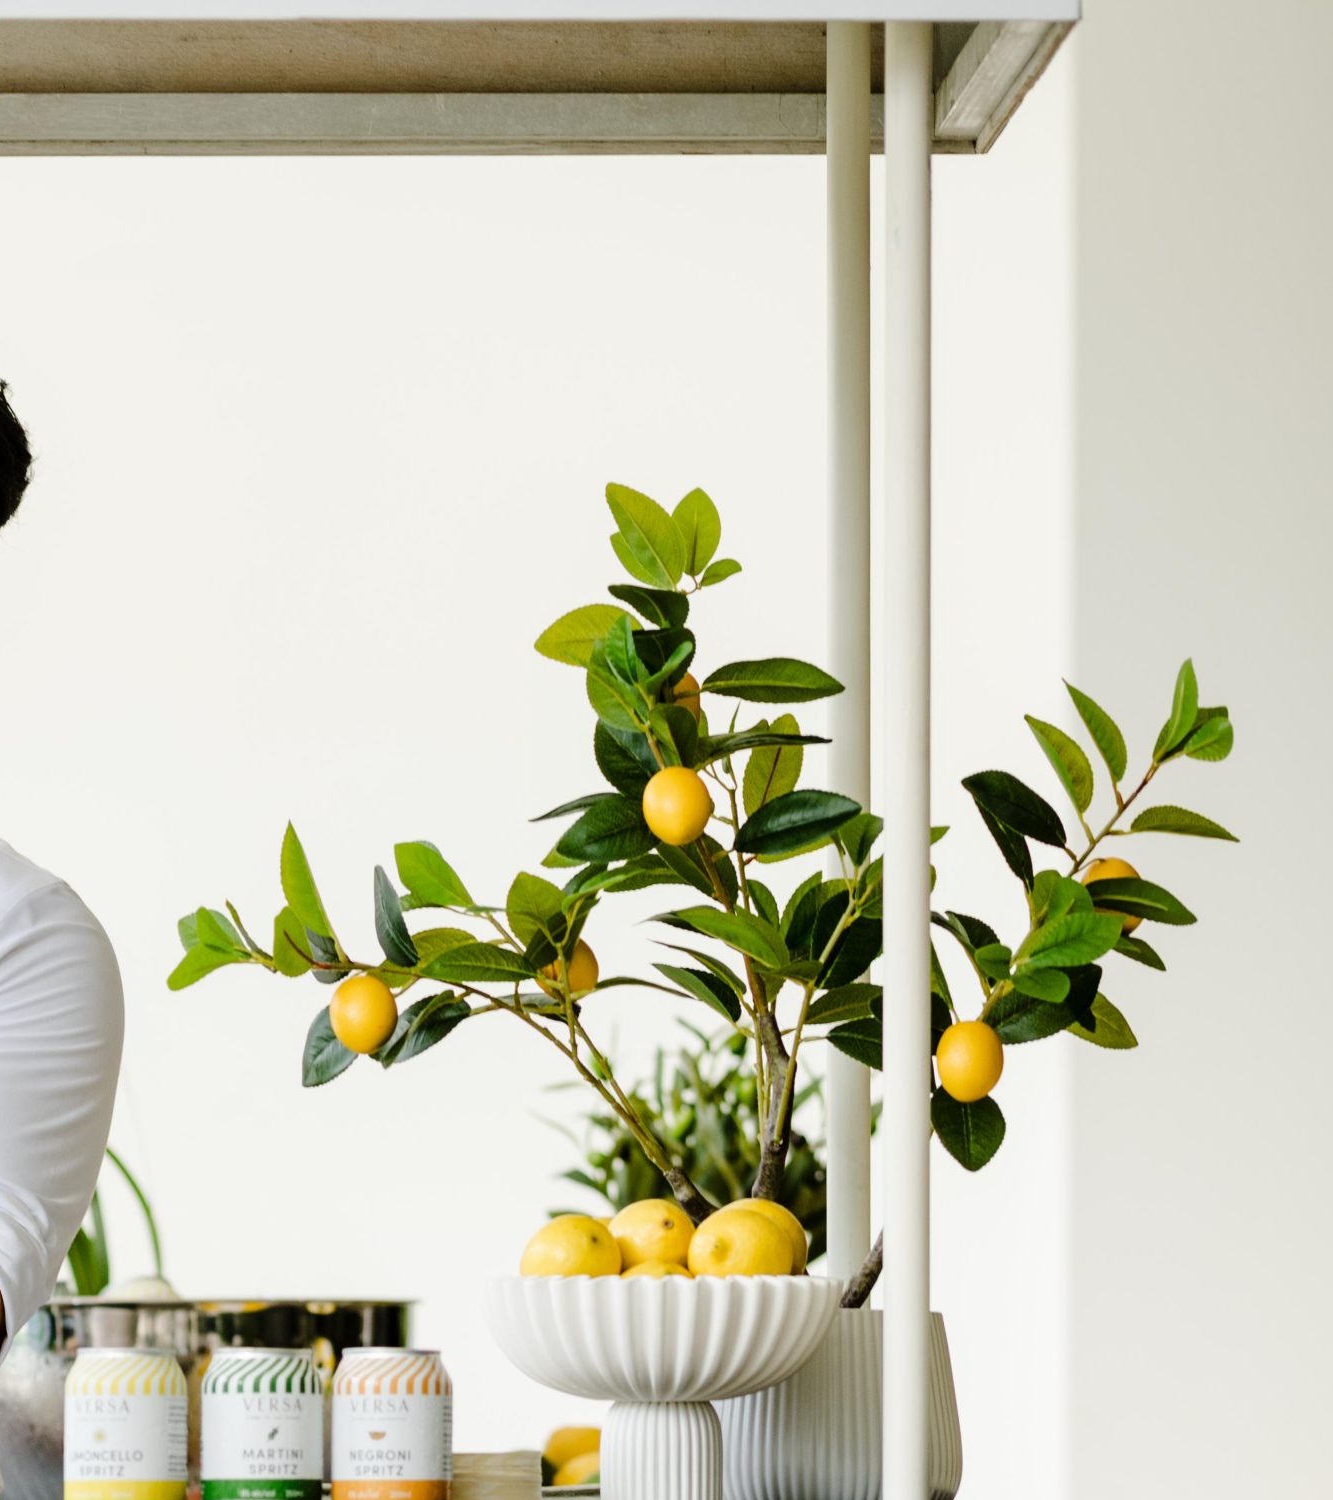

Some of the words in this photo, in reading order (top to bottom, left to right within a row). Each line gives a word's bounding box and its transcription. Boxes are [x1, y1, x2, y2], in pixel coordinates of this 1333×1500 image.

[243, 1398, 303, 1412] VERSA
[350, 1399, 410, 1413] VERSA
[242, 1448, 304, 1460] MARTINI
[349, 1449, 412, 1461] NEGRONI
[79, 1465, 125, 1477] SPRITZ
[249, 1463, 298, 1475] SPRITZ
[355, 1464, 404, 1477] SPRITZ
